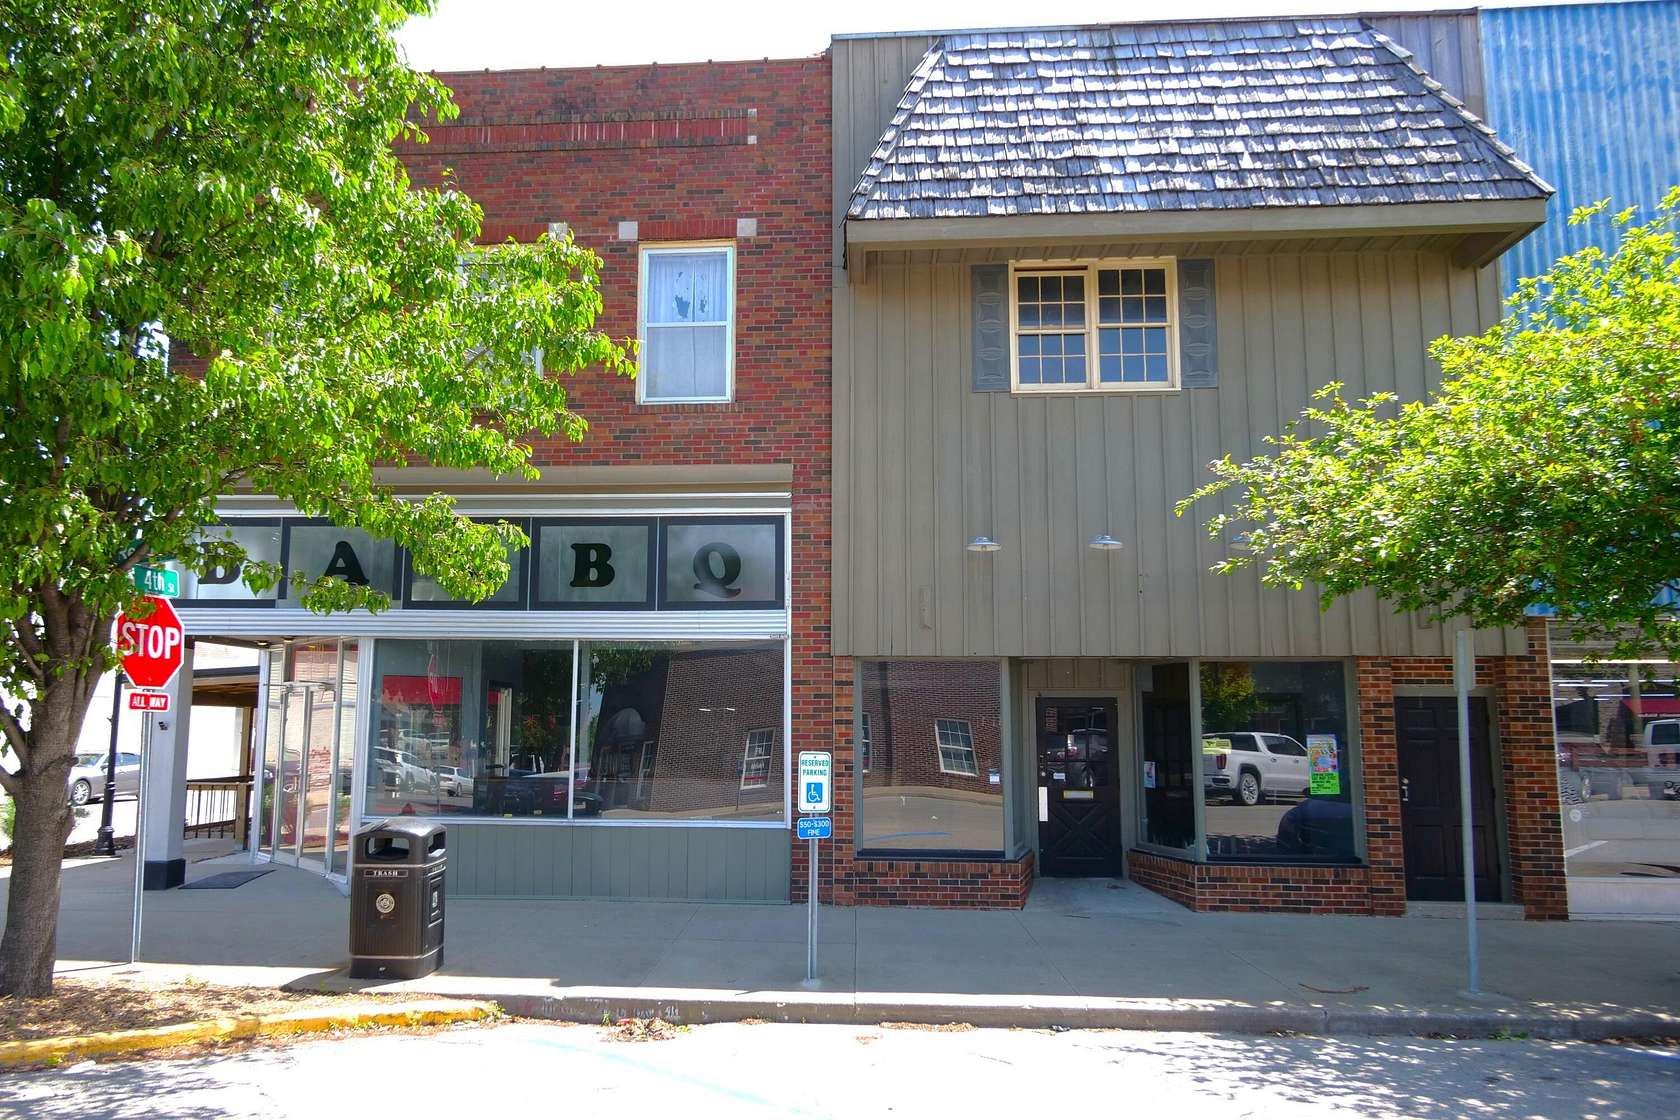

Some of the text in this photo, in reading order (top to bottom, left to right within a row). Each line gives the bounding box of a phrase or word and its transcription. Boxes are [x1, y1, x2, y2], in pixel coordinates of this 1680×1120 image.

[144, 570, 165, 592] 4th
[122, 622, 180, 659] STOP
[131, 696, 167, 708] ALL WAY
[800, 759, 830, 767] RESERVED
[373, 869, 398, 877] TRASH
